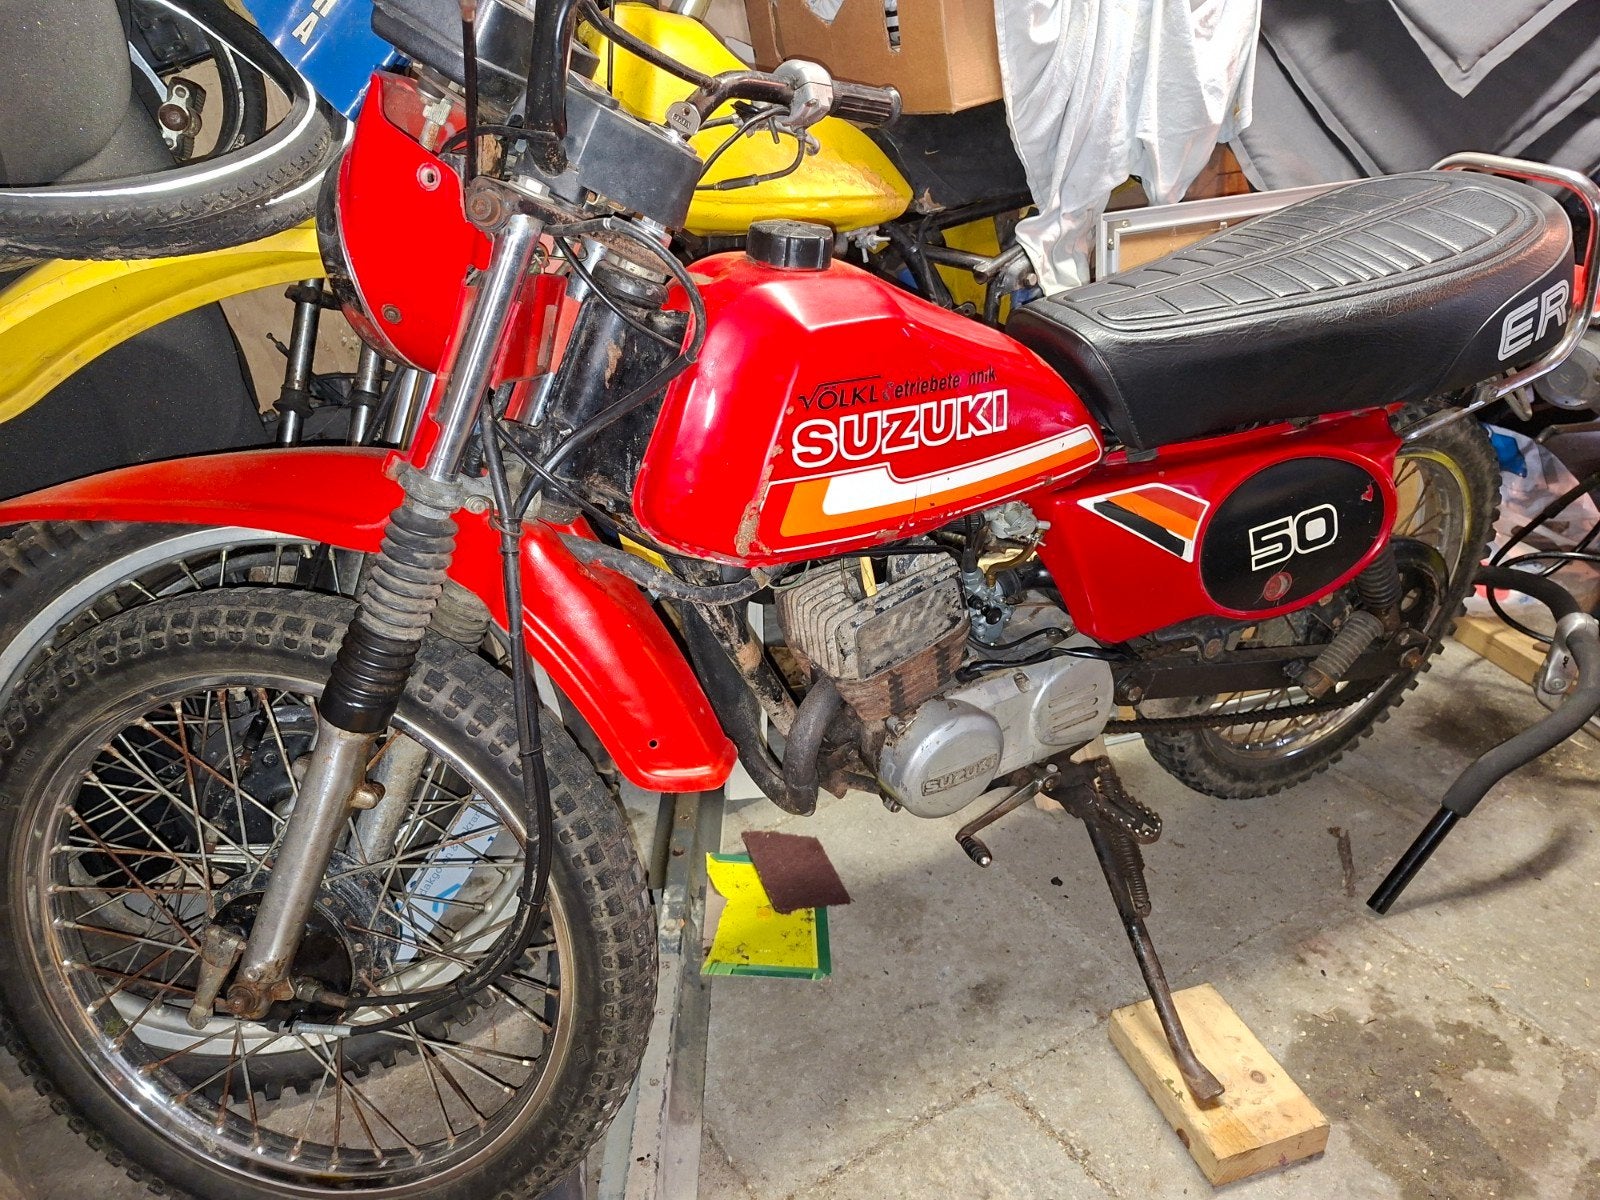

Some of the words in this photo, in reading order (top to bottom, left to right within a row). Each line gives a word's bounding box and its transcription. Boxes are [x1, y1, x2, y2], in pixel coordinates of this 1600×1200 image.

[1497, 279, 1570, 361] ER
[798, 375, 881, 411] VÖLKL
[791, 389, 1008, 468] SUZUKI
[1248, 503, 1339, 571] 50
[923, 757, 997, 794] SUZUKI
